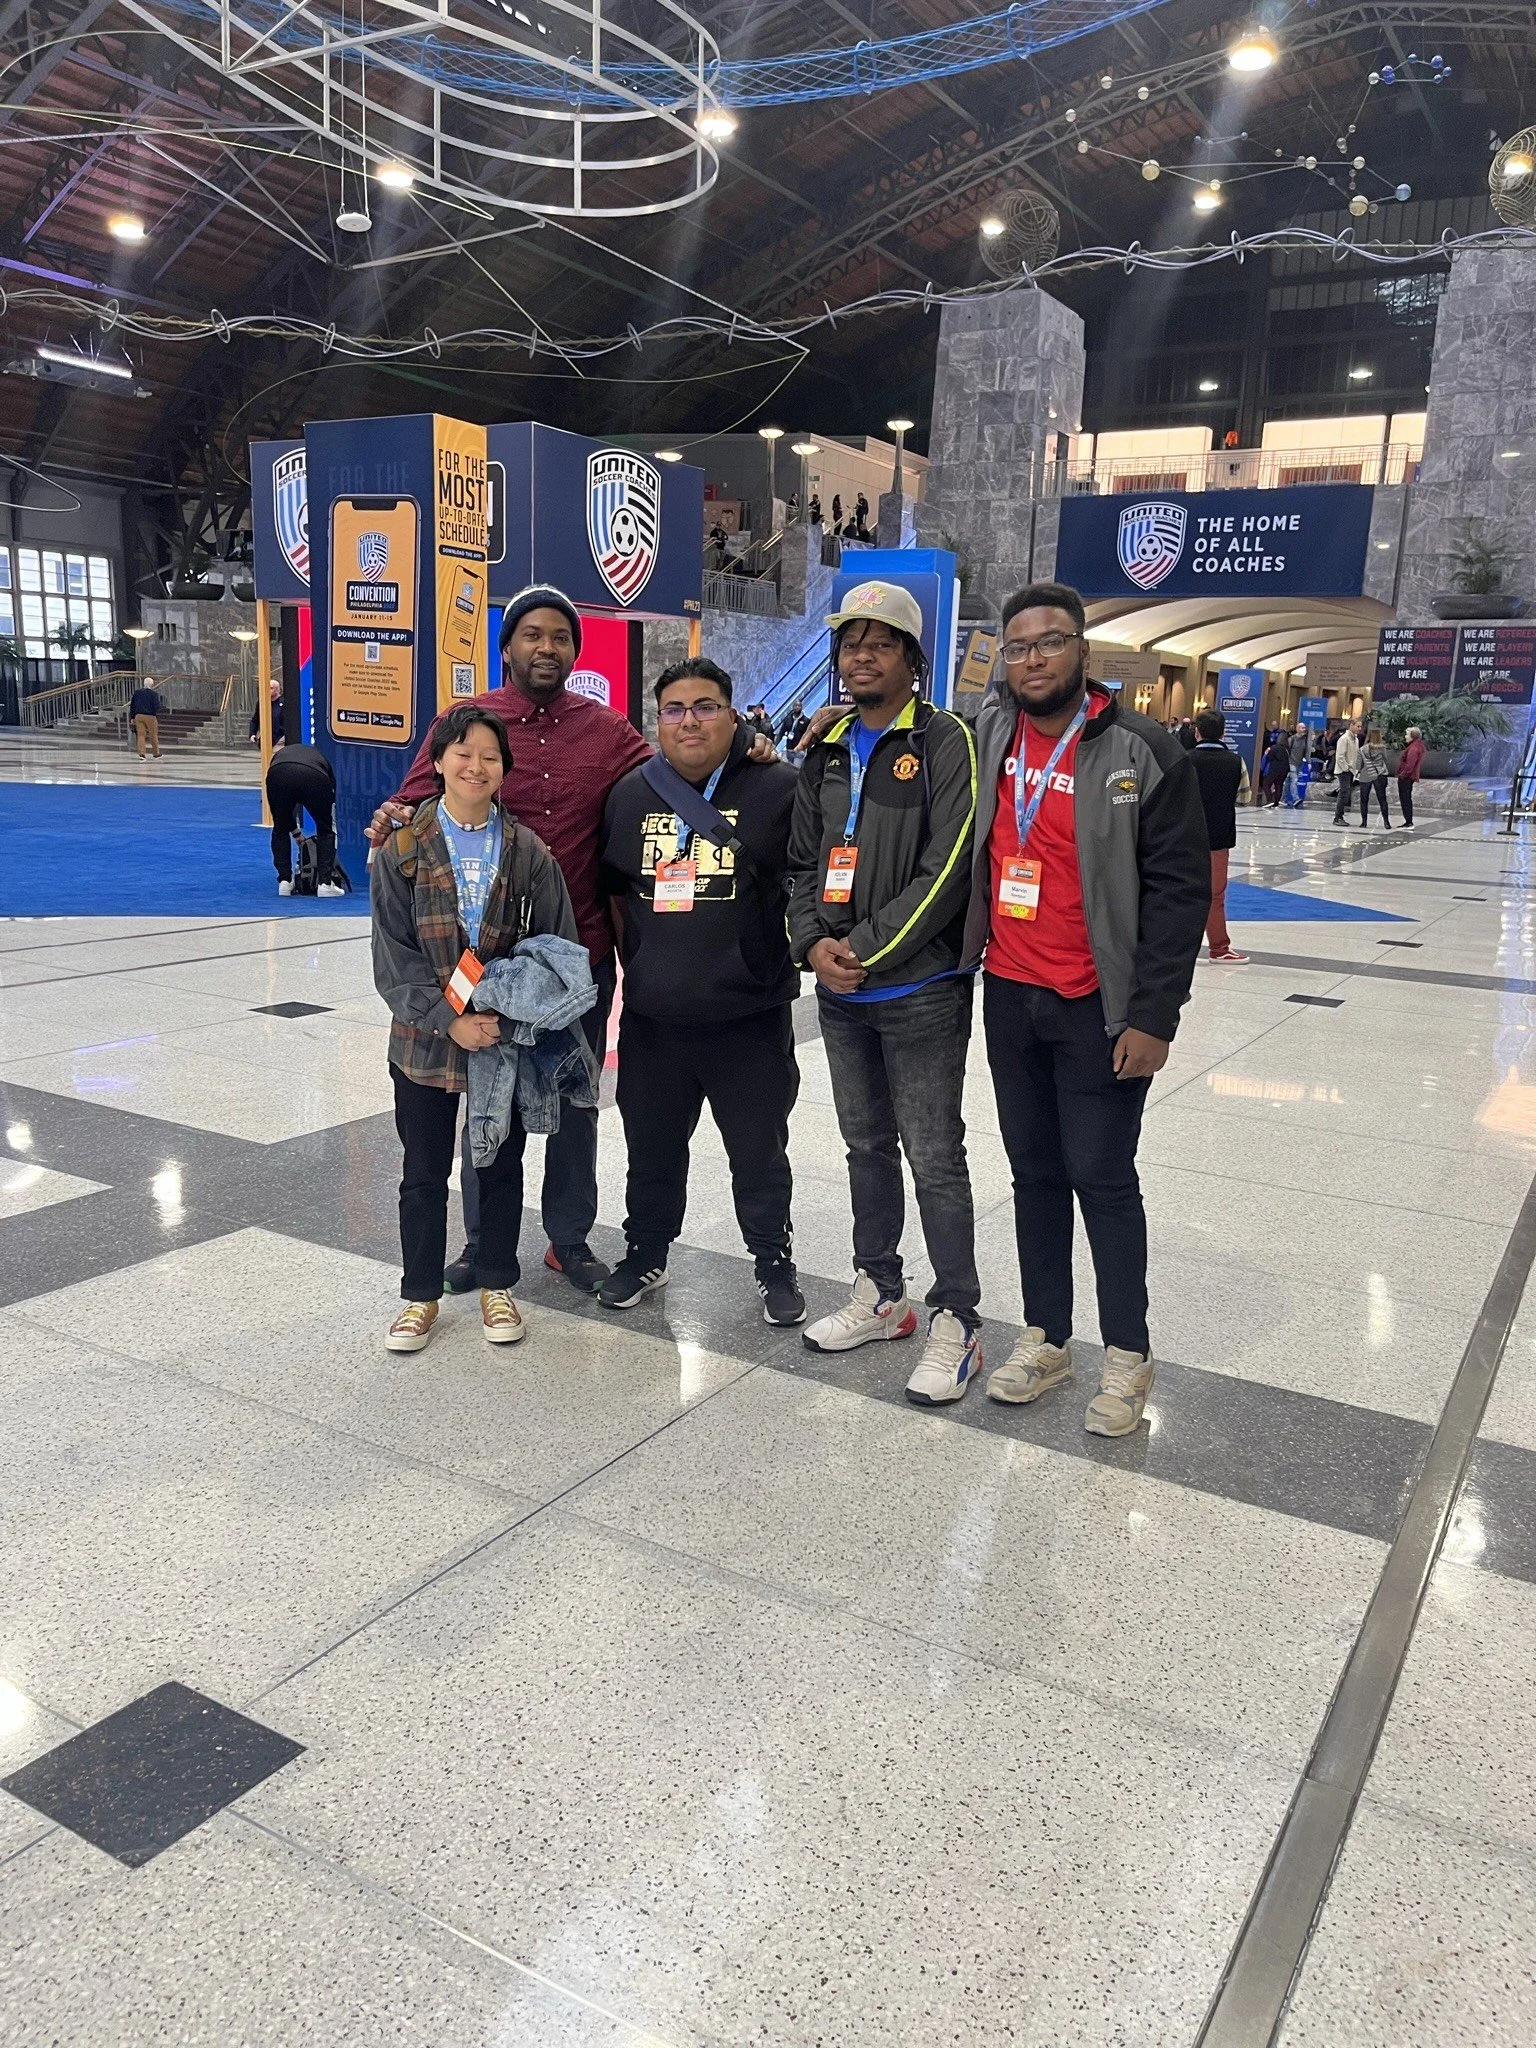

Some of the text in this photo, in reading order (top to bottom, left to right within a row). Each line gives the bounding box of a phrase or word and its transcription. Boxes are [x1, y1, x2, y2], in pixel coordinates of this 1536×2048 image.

[439, 449, 484, 479] FOR THE
[594, 458, 656, 492] UNITED
[440, 470, 484, 513] MOST
[593, 473, 656, 500] SOCCER COACHES
[440, 506, 484, 528] UP-TO-DATE
[1125, 507, 1182, 521] UNITED
[1124, 516, 1181, 526] SOCCER COACHES
[1198, 515, 1300, 533] THE HOME
[360, 535, 387, 543] UNITED
[1194, 537, 1264, 552] OF ALL
[1192, 556, 1285, 572] COACHES
[349, 586, 396, 602] CONVENTION
[337, 630, 407, 641] DOWNLOAD THE APP!
[1385, 630, 1453, 639] WE ARE COACHES
[1464, 630, 1477, 638] WE
[1478, 630, 1495, 638] ARE
[1384, 643, 1396, 651] WE
[1397, 643, 1413, 651] ARE
[1465, 643, 1478, 651] WE
[1479, 643, 1495, 651] ARE
[1379, 657, 1390, 665] WE
[1391, 657, 1405, 665] ARE
[1463, 657, 1532, 665] WE ARE LEADERS
[1398, 670, 1428, 678] WE ARE
[1480, 670, 1510, 679] WE ARE
[567, 676, 606, 691] UNITED
